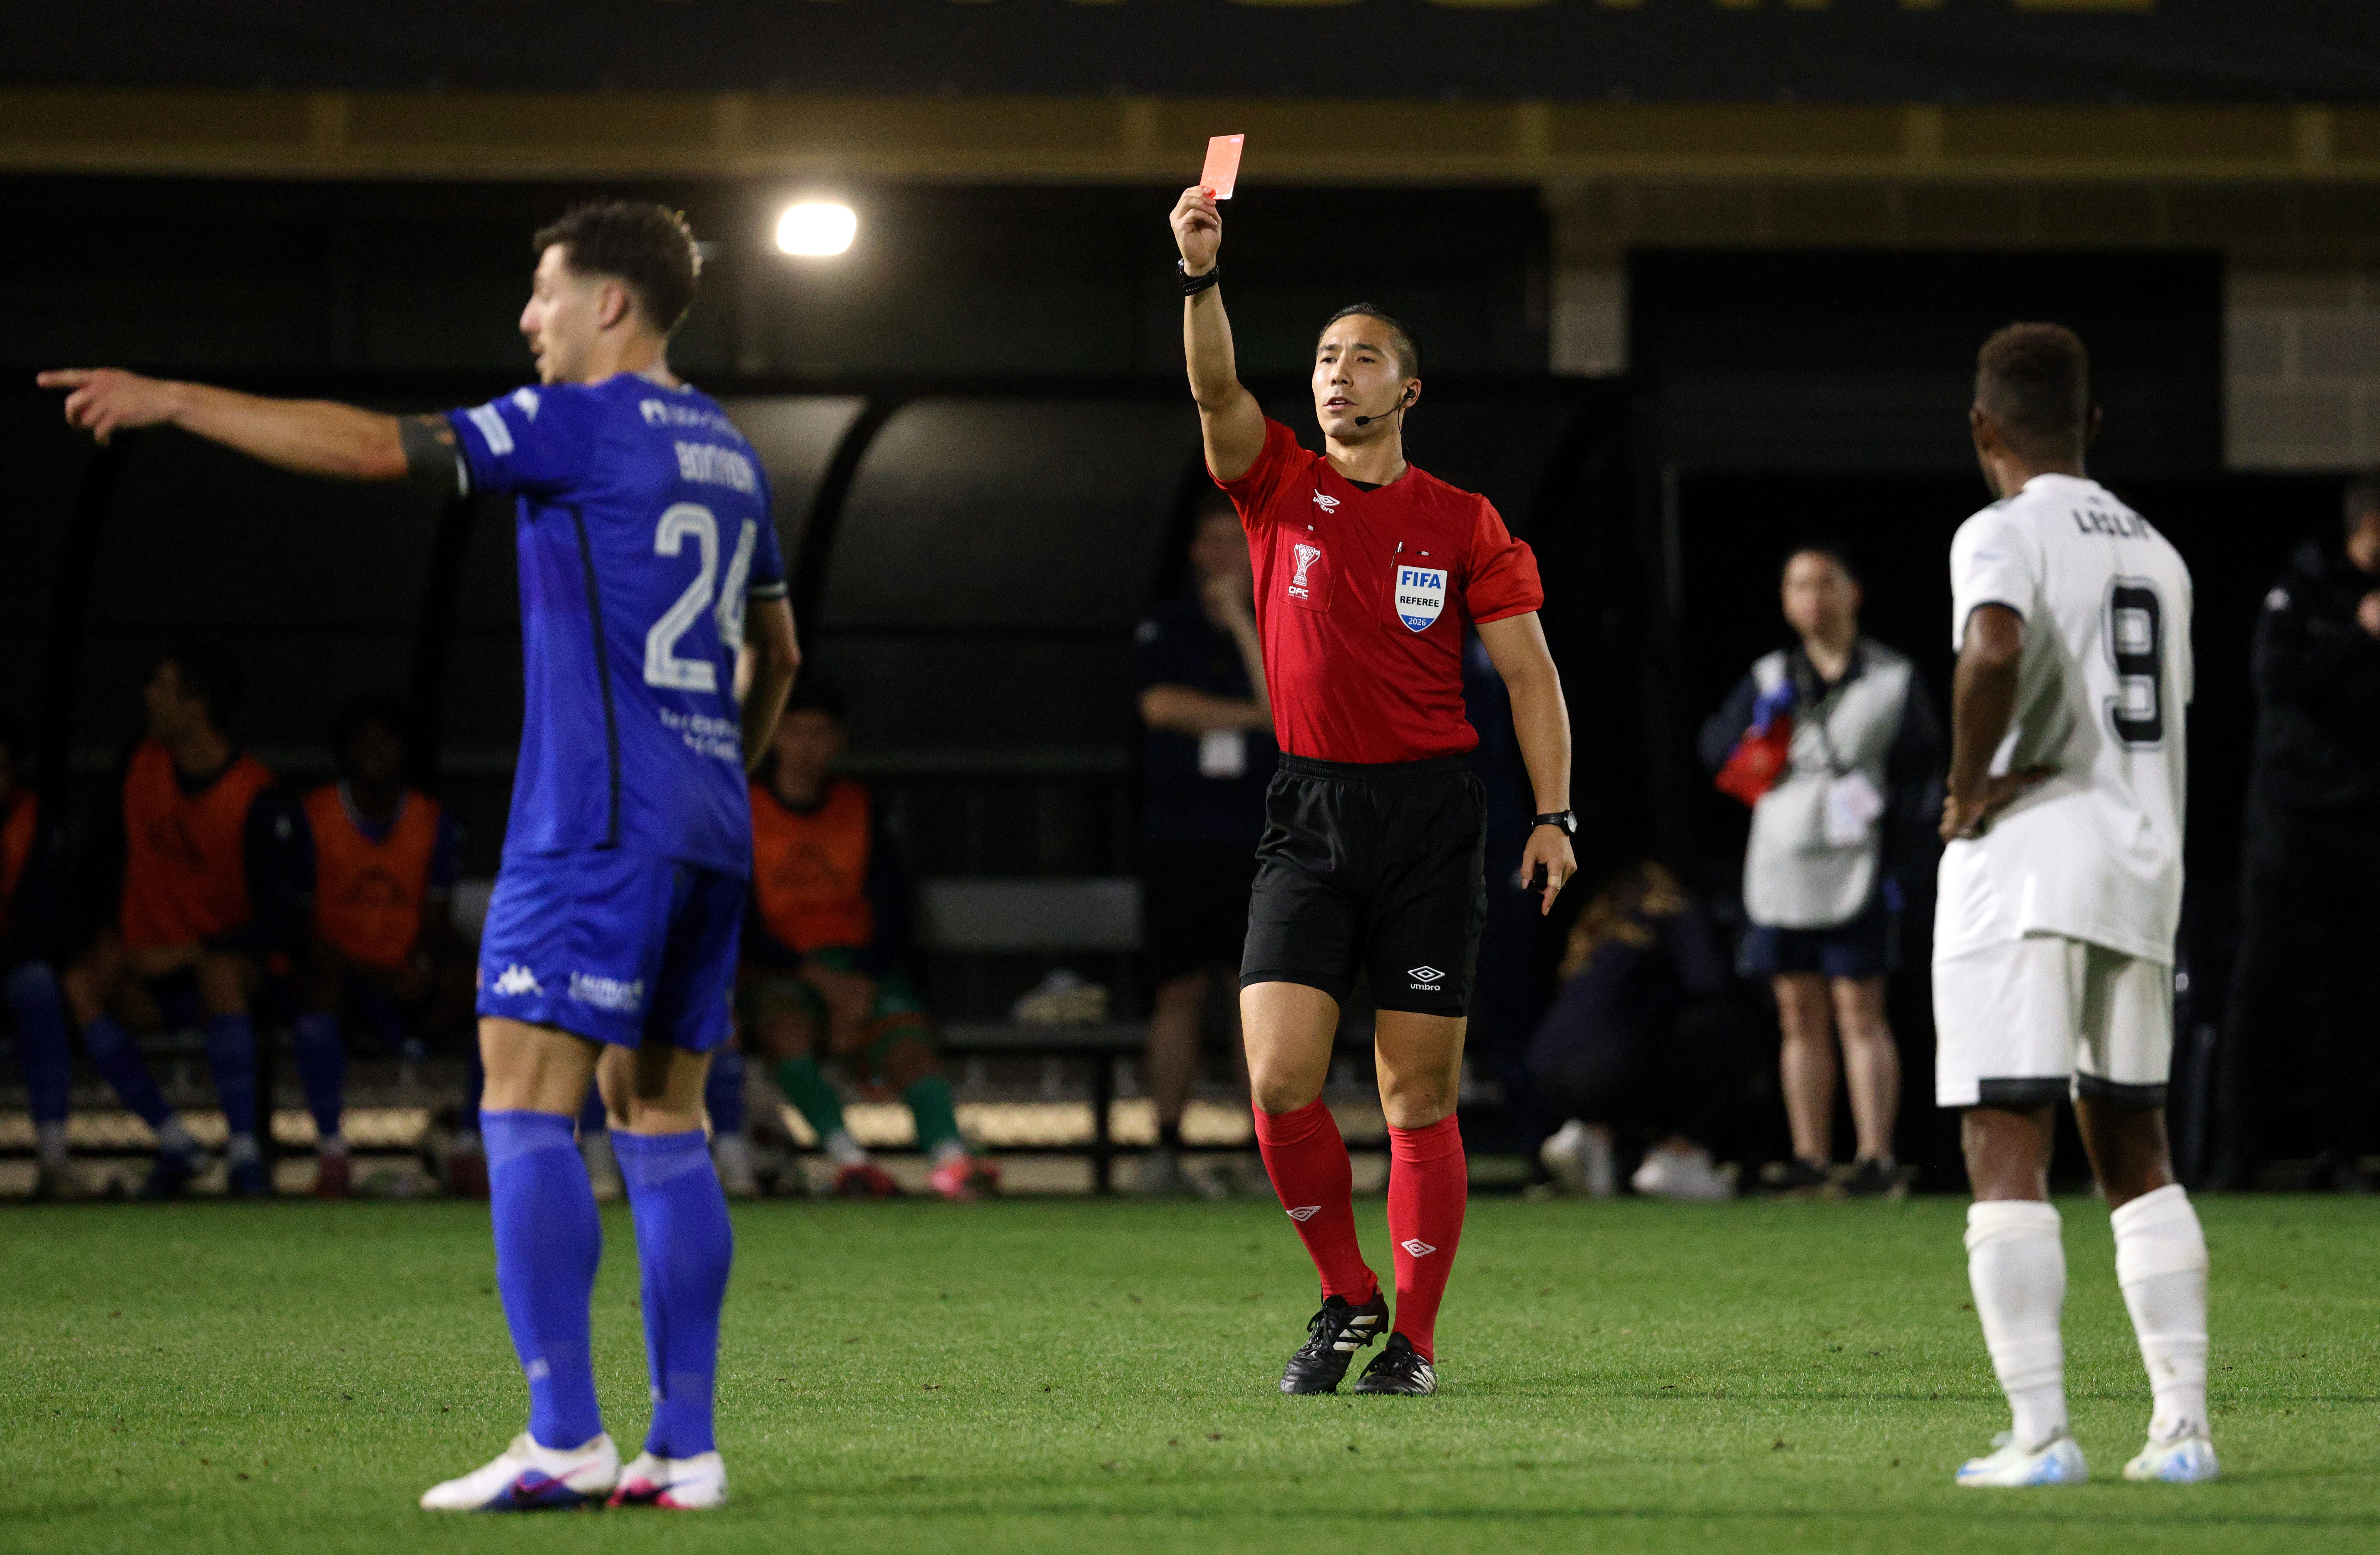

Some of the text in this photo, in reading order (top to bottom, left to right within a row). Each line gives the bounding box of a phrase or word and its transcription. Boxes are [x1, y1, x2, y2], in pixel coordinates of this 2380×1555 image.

[1401, 571, 1441, 589] FIFA
[643, 503, 757, 693] 24
[1288, 586, 1309, 597] OFC
[1400, 596, 1439, 607] REFEREE
[1408, 617, 1426, 626] 2026
[2103, 575, 2164, 751] 9
